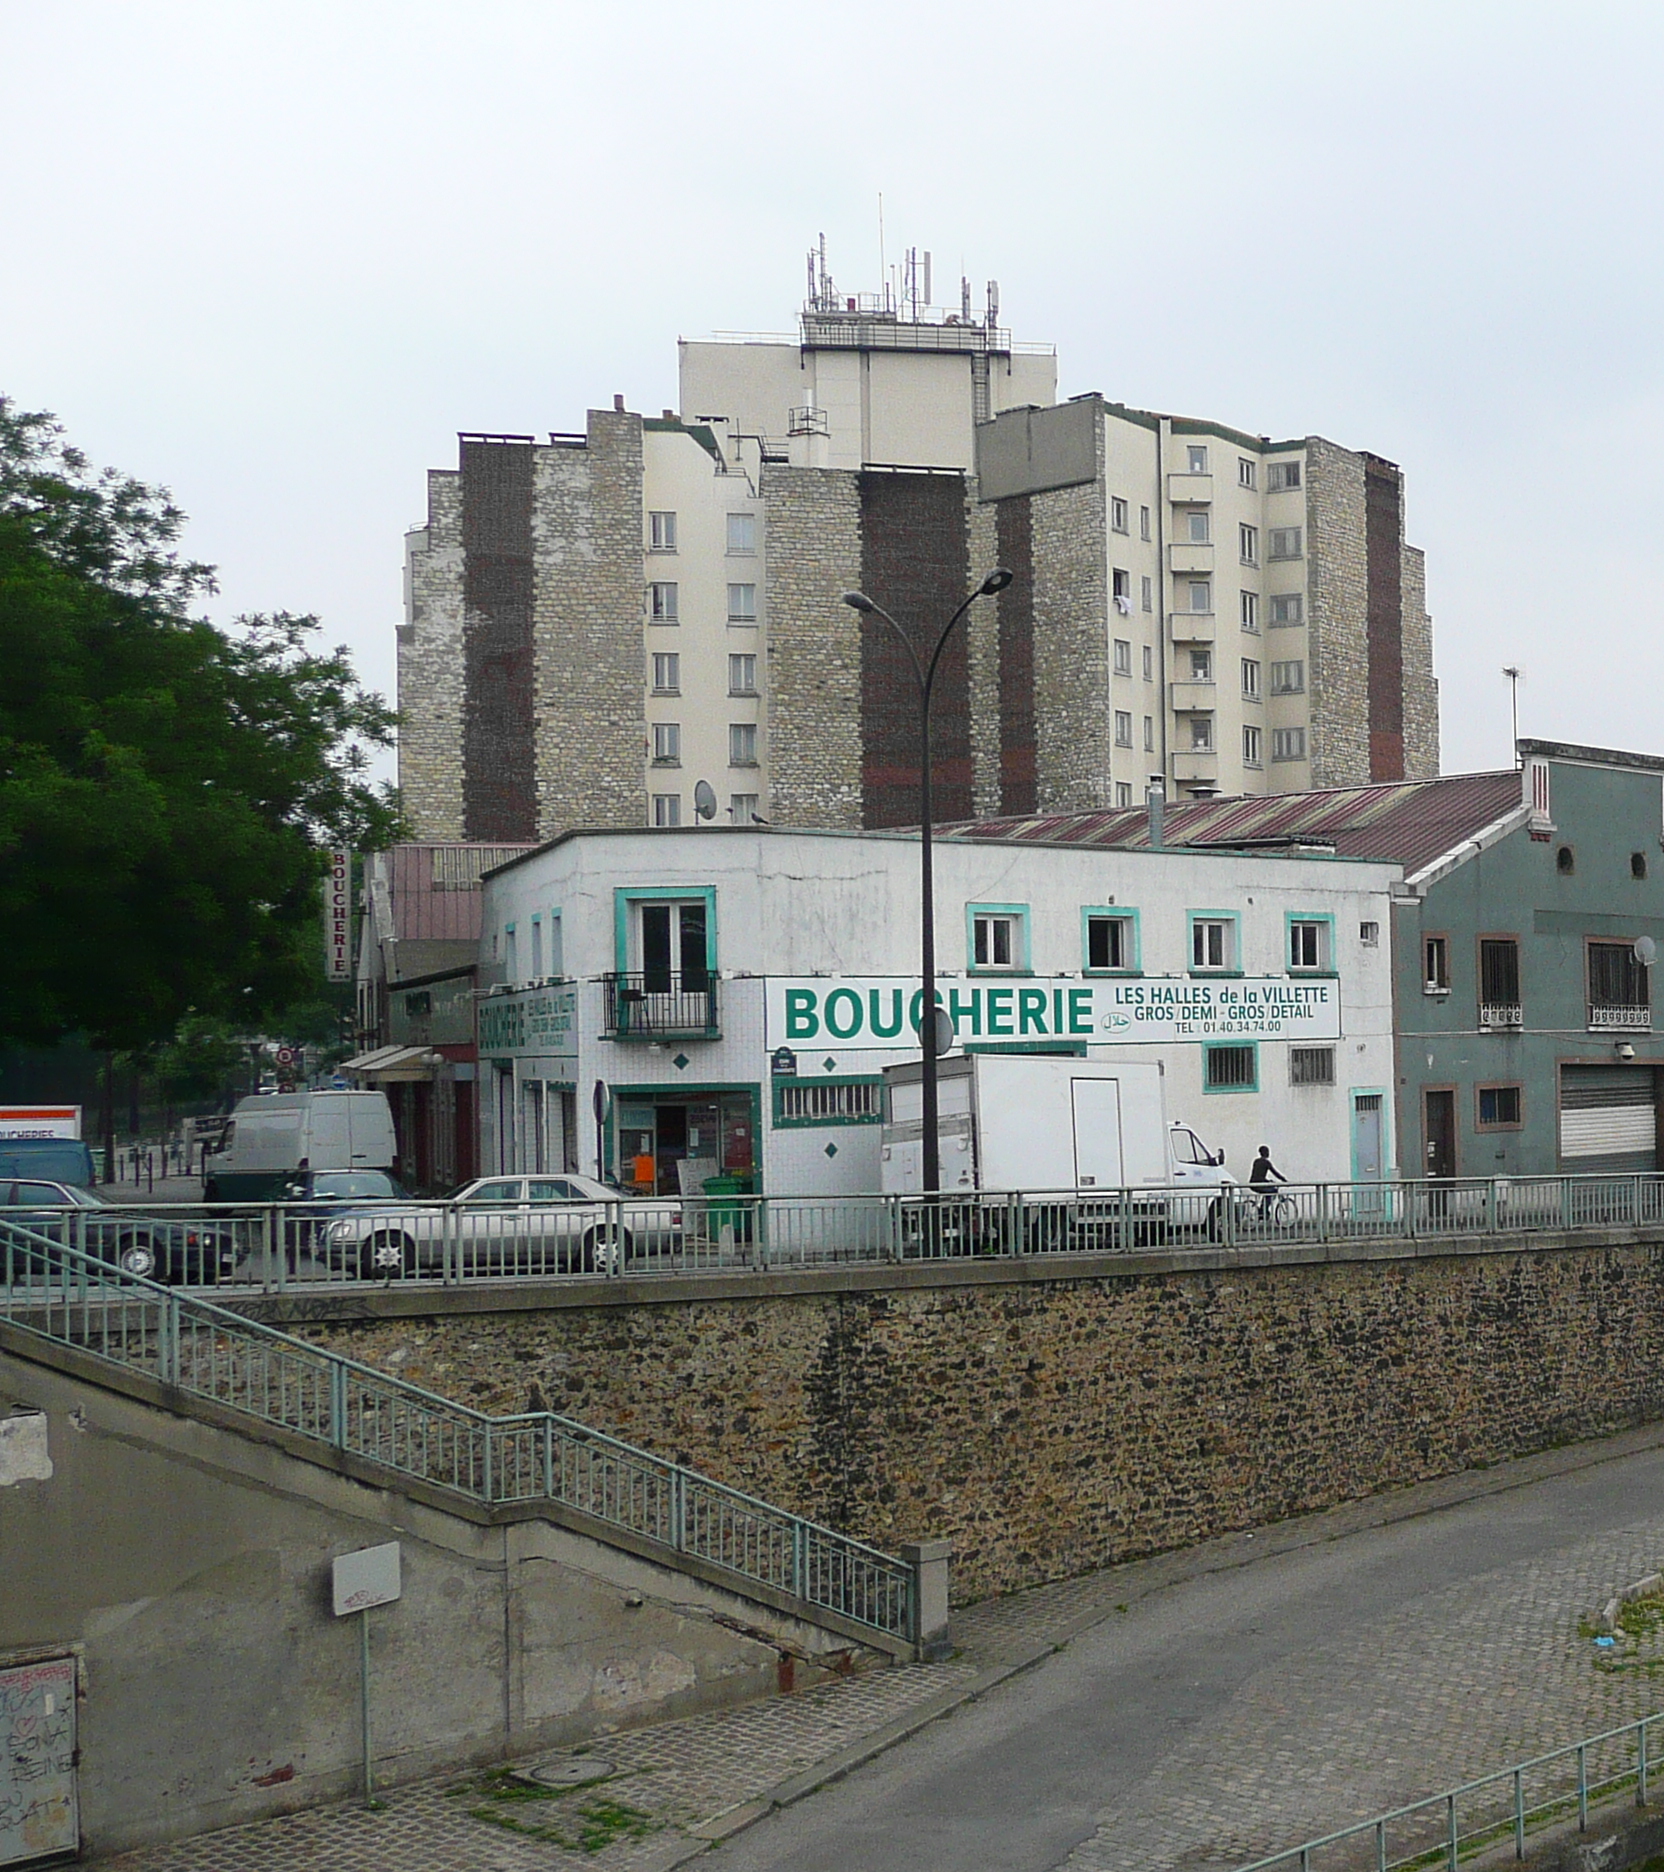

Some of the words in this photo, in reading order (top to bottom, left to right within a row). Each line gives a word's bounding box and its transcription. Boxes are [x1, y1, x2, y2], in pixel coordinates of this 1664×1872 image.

[333, 853, 347, 972] BOUCHERIE
[1115, 987, 1144, 1004] LES
[1150, 987, 1211, 1004] HALLES
[1219, 986, 1238, 1004] de
[1244, 986, 1258, 1003] la
[1262, 986, 1328, 1003] VILLETTE
[785, 988, 1094, 1039] BOUCHERIE
[1203, 1021, 1282, 1033] 01.40.34.74.00
